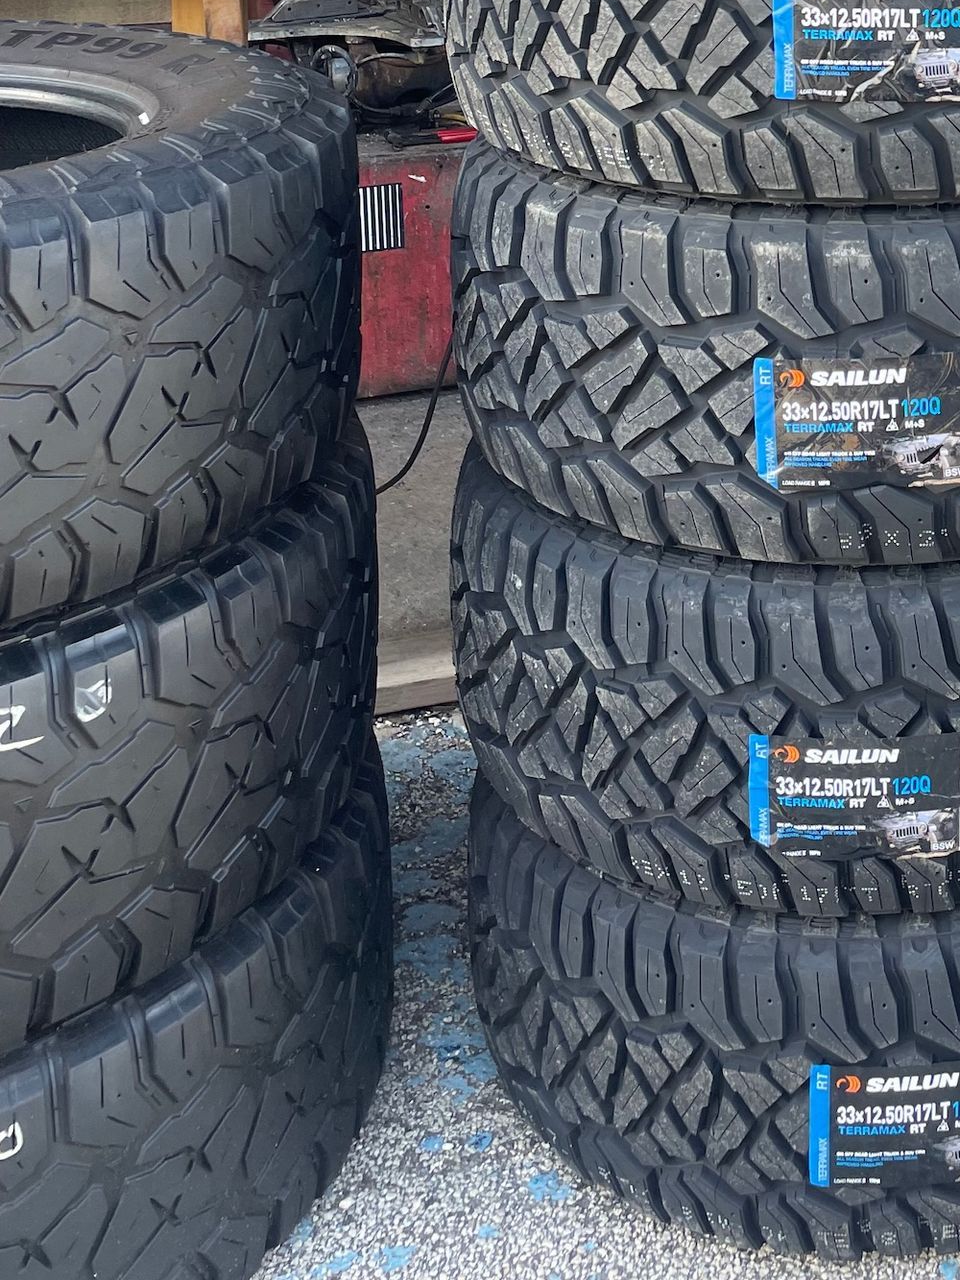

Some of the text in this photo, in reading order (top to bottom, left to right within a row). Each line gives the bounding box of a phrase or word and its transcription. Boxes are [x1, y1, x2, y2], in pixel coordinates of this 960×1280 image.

[800, 7, 921, 29] 33x12.50R17LT
[802, 29, 874, 41] TERRAMAX
[877, 29, 896, 41] RT
[783, 42, 794, 94] TERRAMAX
[759, 366, 772, 386] RT
[809, 367, 907, 387] SAILUN
[782, 396, 941, 422] 33x12.50R17LT 120Q
[783, 422, 854, 433] TERRAMAX
[857, 421, 875, 433] RT
[755, 742, 767, 759] RT
[804, 747, 900, 765] SAILUN
[775, 775, 931, 797] 33x12.50R17LT 120Q
[777, 797, 845, 809] TERRAMAX
[849, 798, 867, 809] RT
[932, 841, 954, 851] BSW
[816, 1071, 828, 1091] RT
[865, 1071, 960, 1093] SAILUN
[836, 1101, 950, 1125] 33x12.50R17LT
[838, 1123, 906, 1135] TERRAMAX
[909, 1122, 927, 1134] RT
[818, 1137, 829, 1183] TERRAMAX
